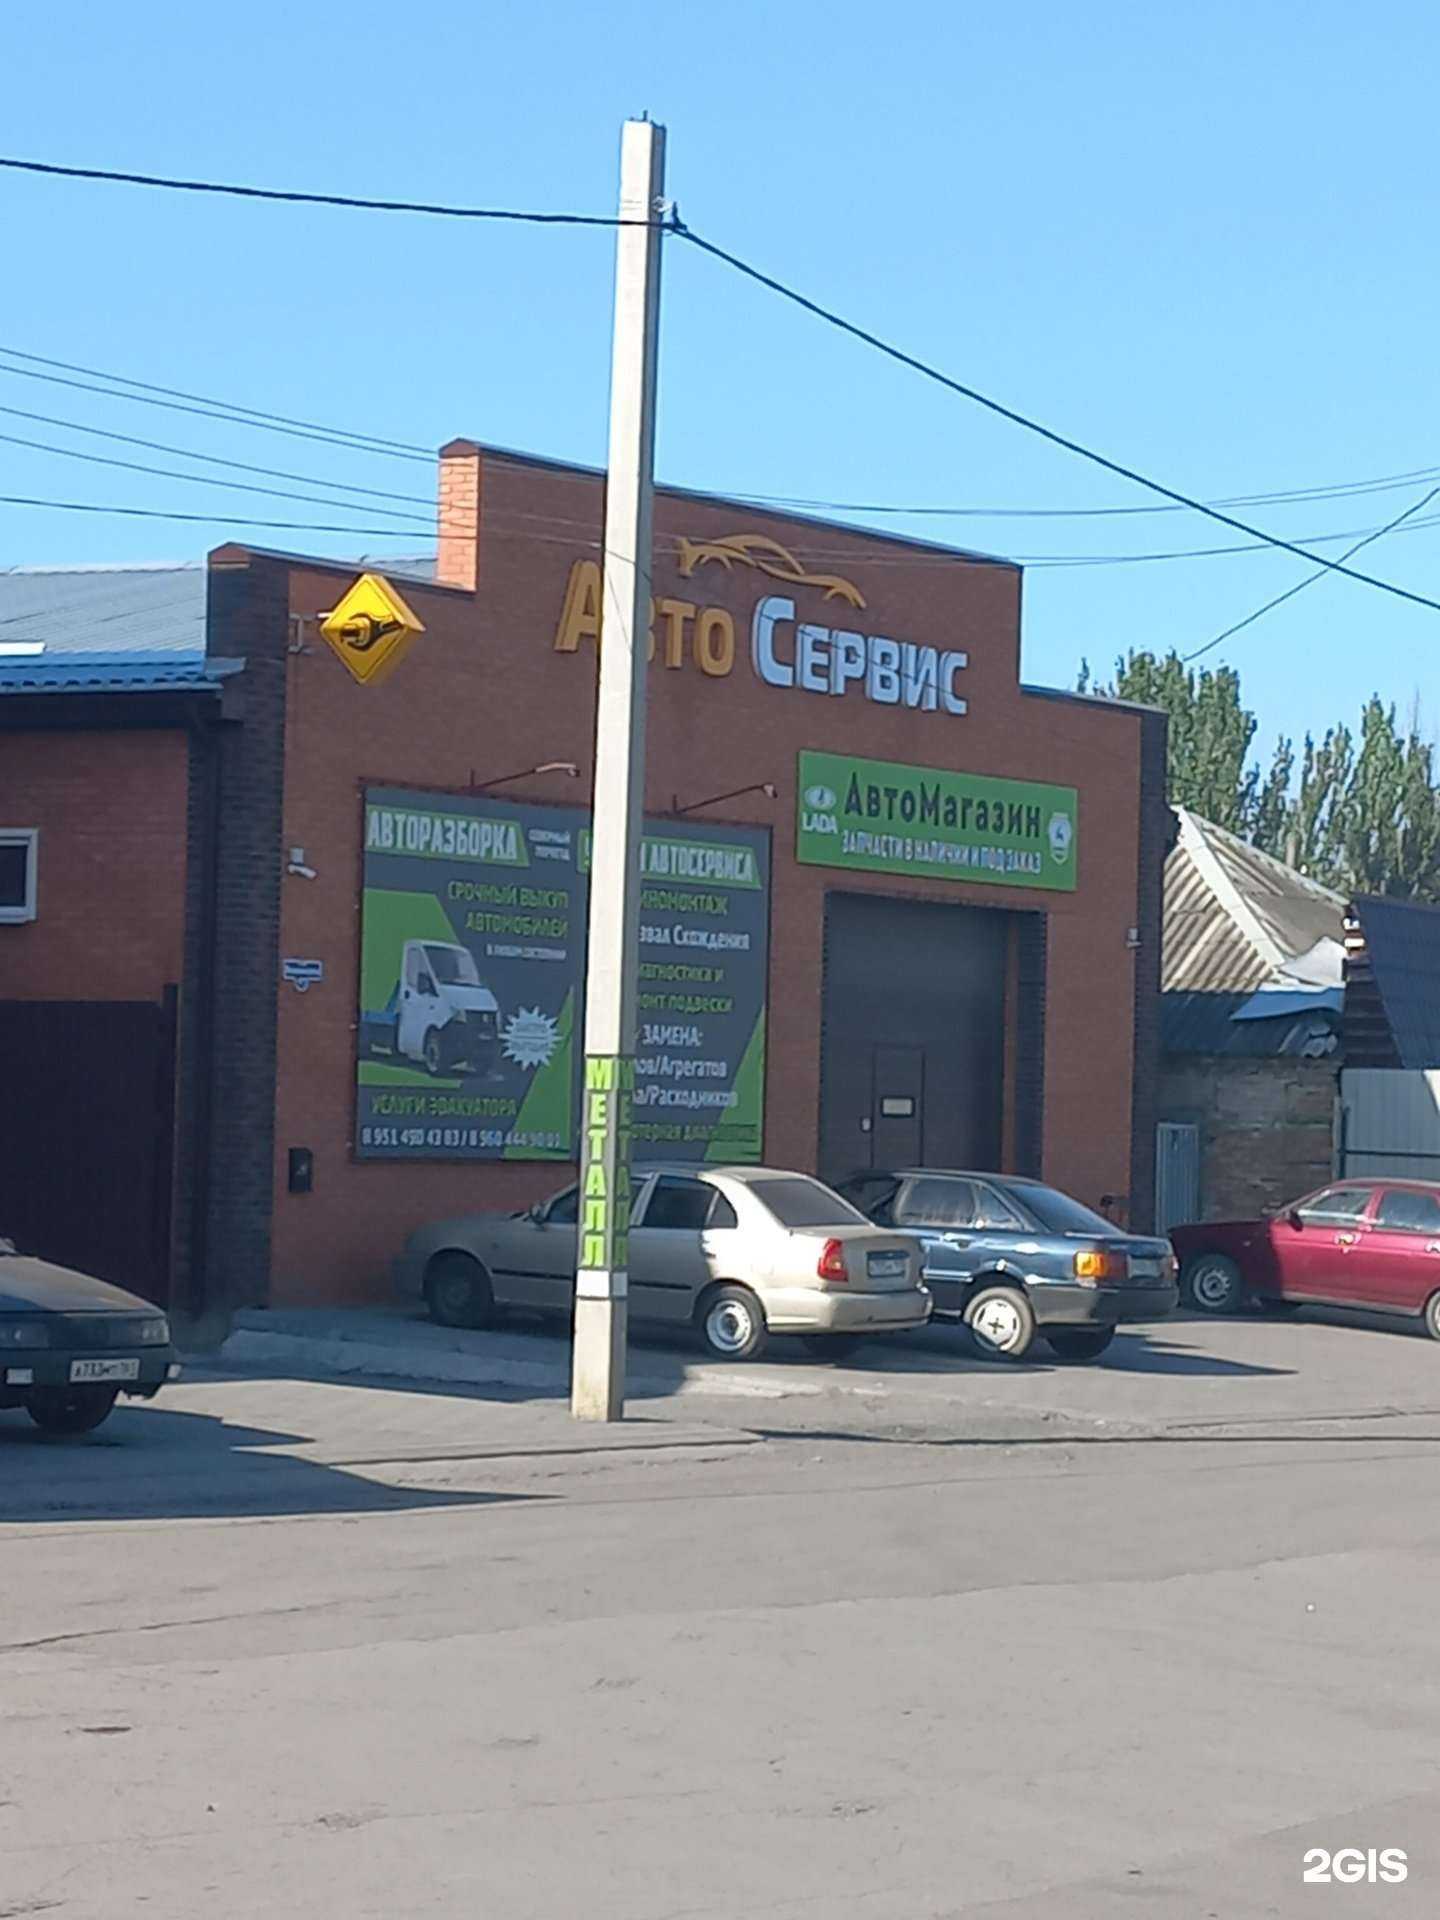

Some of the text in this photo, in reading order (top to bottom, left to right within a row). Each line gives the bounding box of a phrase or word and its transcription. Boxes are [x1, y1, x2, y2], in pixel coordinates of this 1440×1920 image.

[802, 812, 838, 834] LADA
[844, 771, 1041, 838] АвтоМагазин
[368, 811, 518, 861] АВТОРАЗБОРКА
[842, 830, 904, 858] ЗАПЧАСТИ
[1005, 851, 1041, 875] ЗАКАЗ
[649, 843, 752, 882] АВТОСЕРВИСА
[640, 925, 671, 944] звал
[642, 1023, 705, 1047] ЗАМЕНА:
[577, 1058, 613, 1267] МЕТАЛЛ
